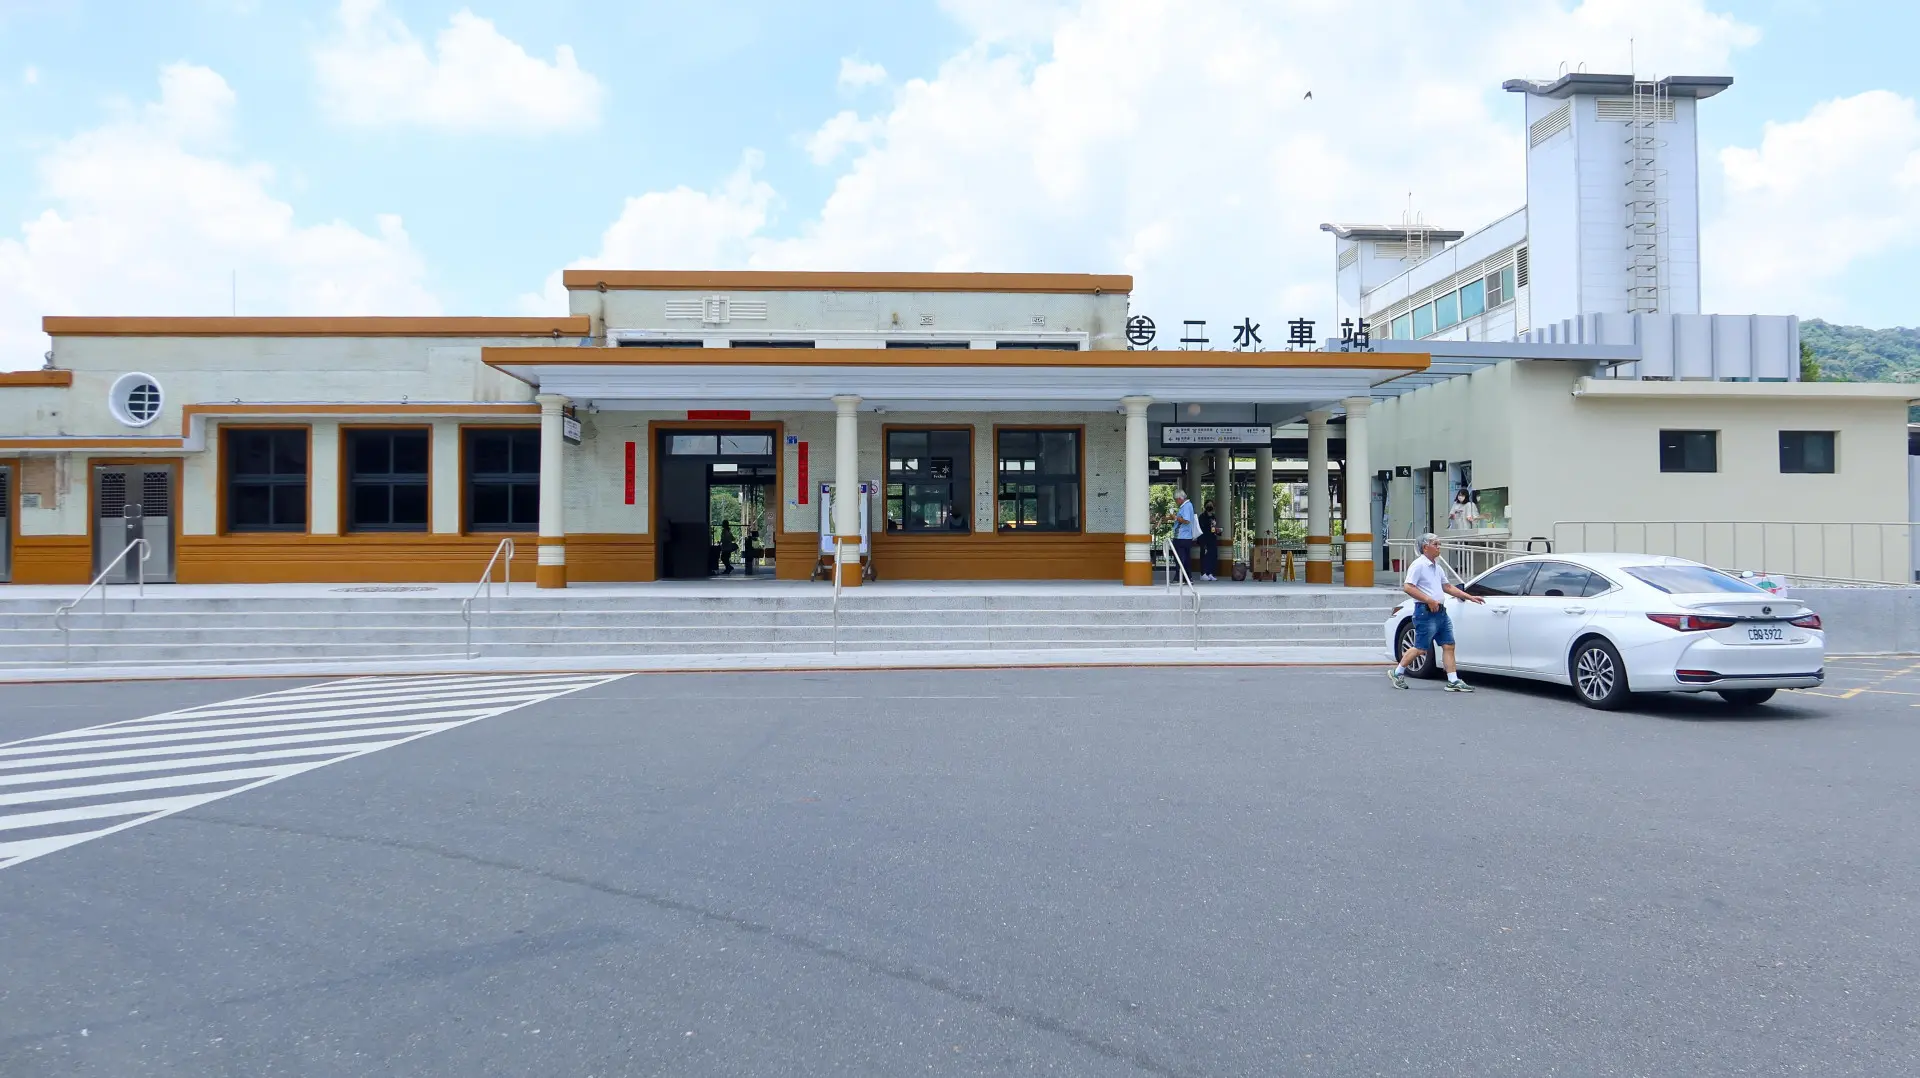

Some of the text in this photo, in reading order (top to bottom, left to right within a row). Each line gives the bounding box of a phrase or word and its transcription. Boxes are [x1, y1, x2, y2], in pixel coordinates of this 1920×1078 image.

[1180, 317, 1371, 349] 二水車站
[930, 465, 950, 474] 二水
